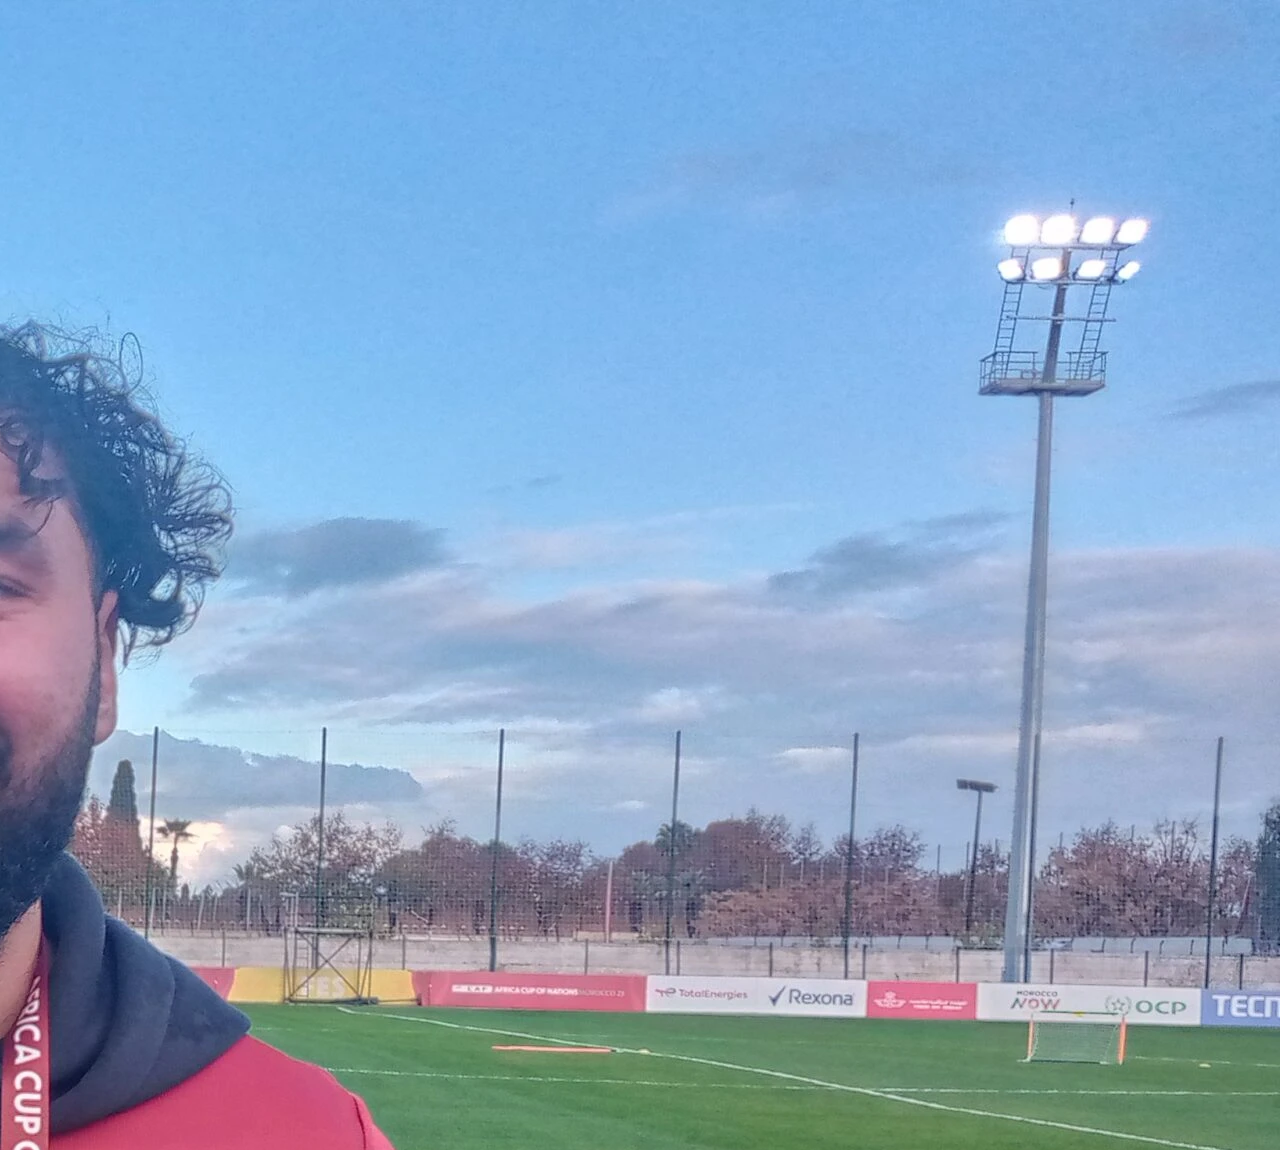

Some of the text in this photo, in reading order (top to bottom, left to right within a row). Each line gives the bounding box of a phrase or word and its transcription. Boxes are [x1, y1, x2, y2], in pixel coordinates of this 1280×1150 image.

[679, 989, 748, 1000] TotalEnergies
[788, 988, 853, 1006] Rexona
[1011, 998, 1060, 1011] NOW
[1135, 1000, 1187, 1015] OCP
[13, 1069, 42, 1135] CUP
